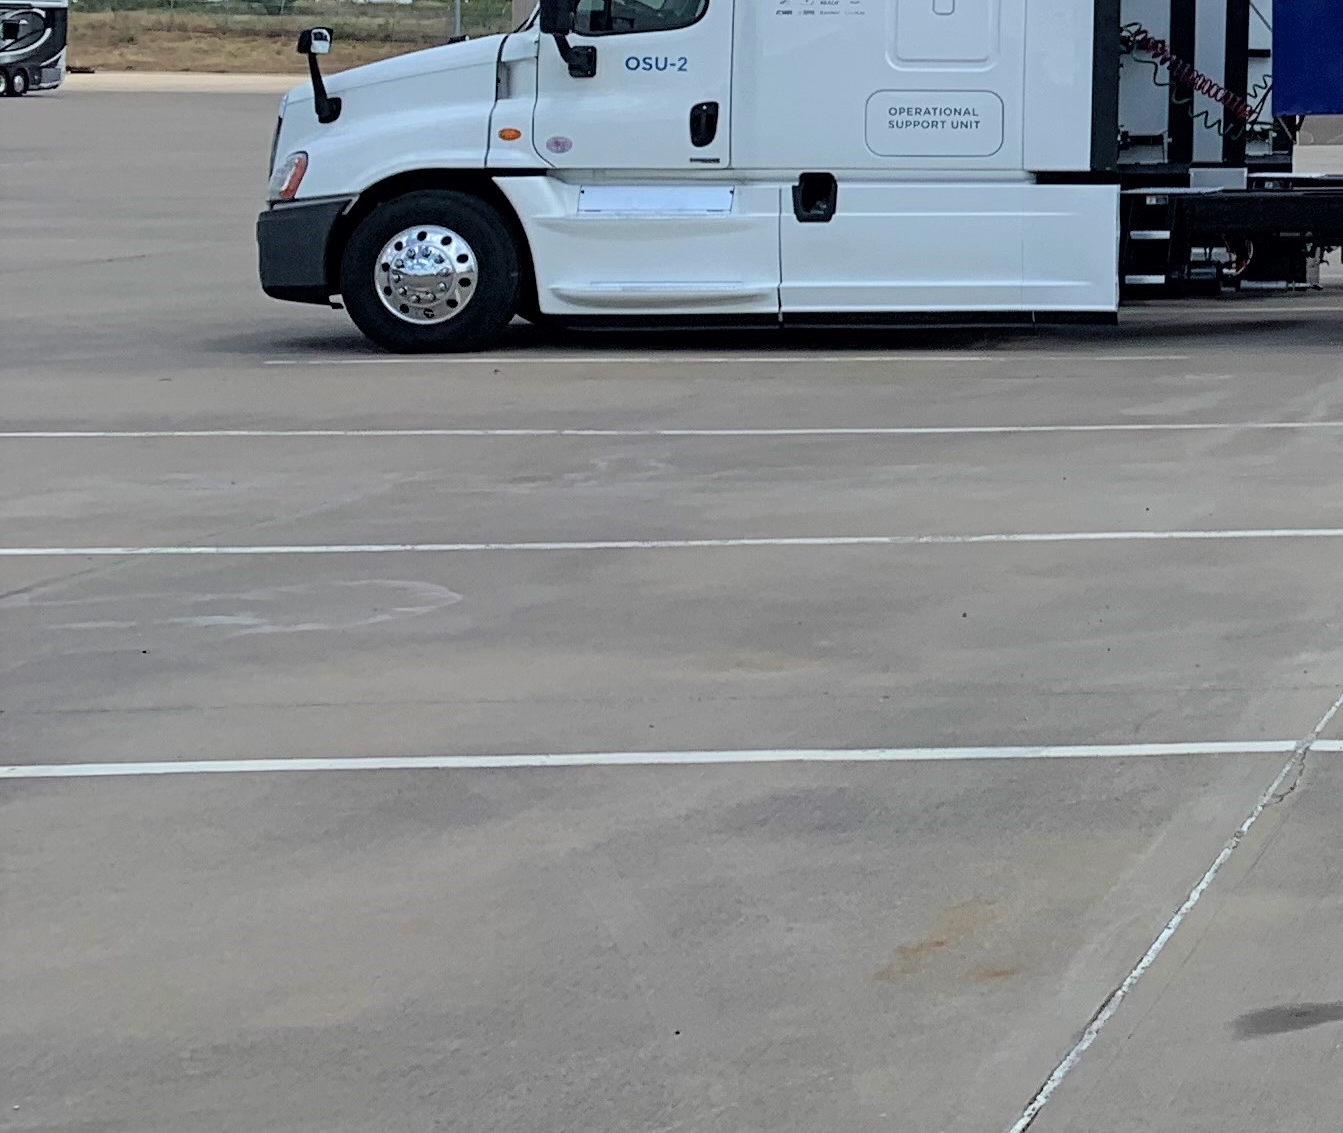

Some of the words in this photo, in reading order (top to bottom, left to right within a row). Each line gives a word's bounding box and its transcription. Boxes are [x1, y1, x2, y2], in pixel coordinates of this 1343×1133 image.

[625, 56, 688, 72] OSU-2
[888, 107, 980, 117] OPERATIONAL
[888, 120, 946, 129] SUPPORT
[951, 120, 981, 129] UNIT
